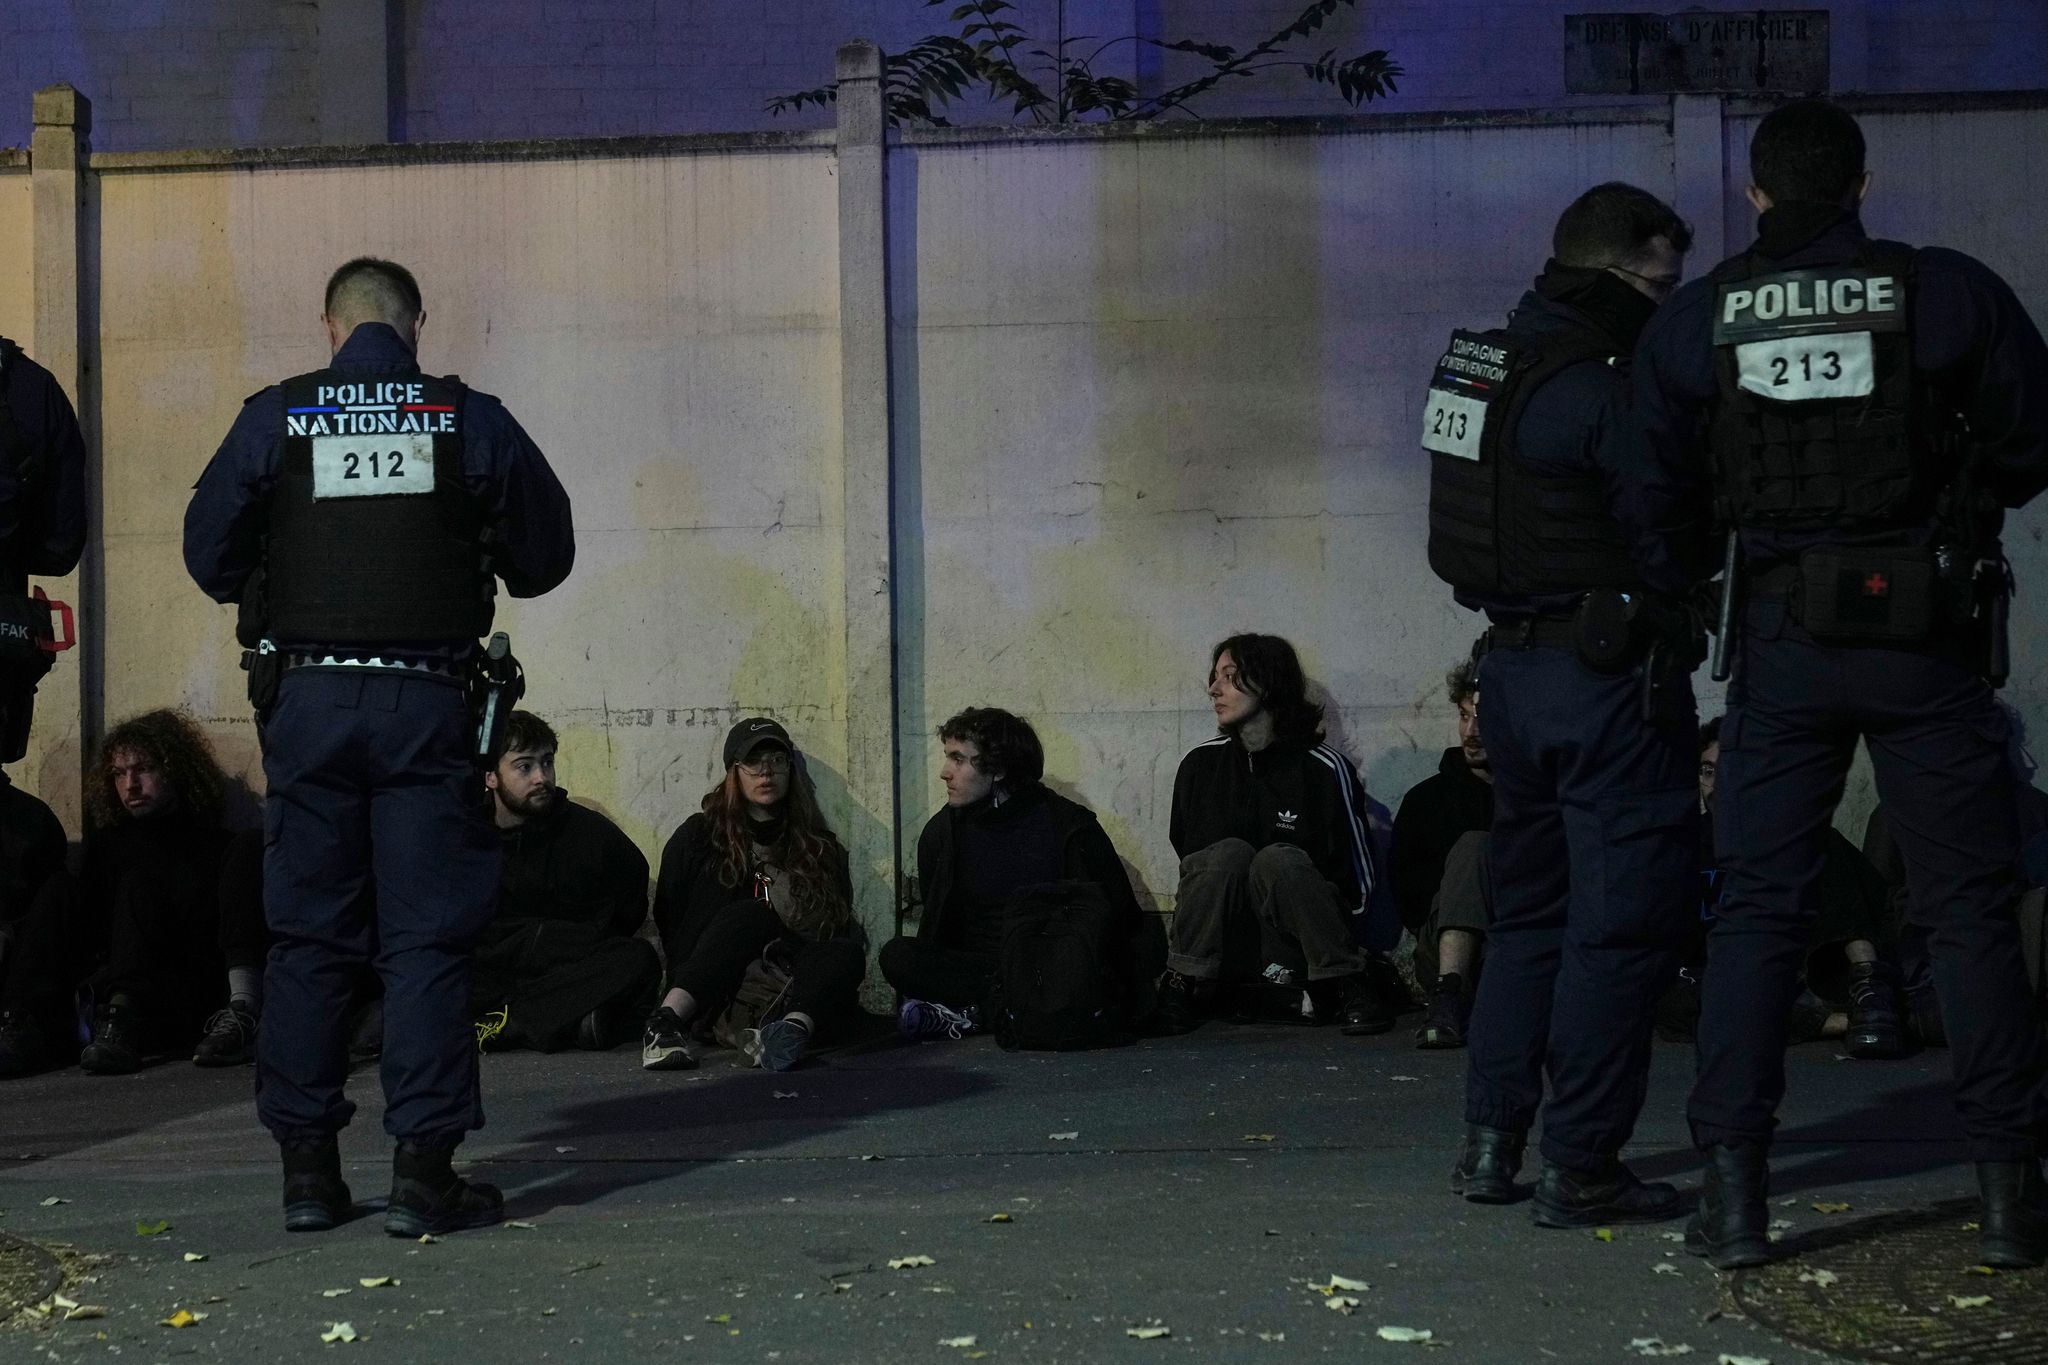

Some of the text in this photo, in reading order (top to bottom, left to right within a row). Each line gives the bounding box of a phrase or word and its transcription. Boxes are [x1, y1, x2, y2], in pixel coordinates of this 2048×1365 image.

[1689, 18, 1808, 41] D'AFFICHER
[1722, 275, 1897, 324] POLICE
[1452, 337, 1508, 365] COMPAGNIE
[1439, 354, 1509, 383] D'INTERVENTION
[1770, 351, 1841, 386] 213
[317, 382, 424, 406] POLICE
[286, 412, 456, 437] NATIONALE
[1432, 408, 1468, 441] 213
[343, 450, 405, 480] 212
[1275, 821, 1296, 831] adidas
